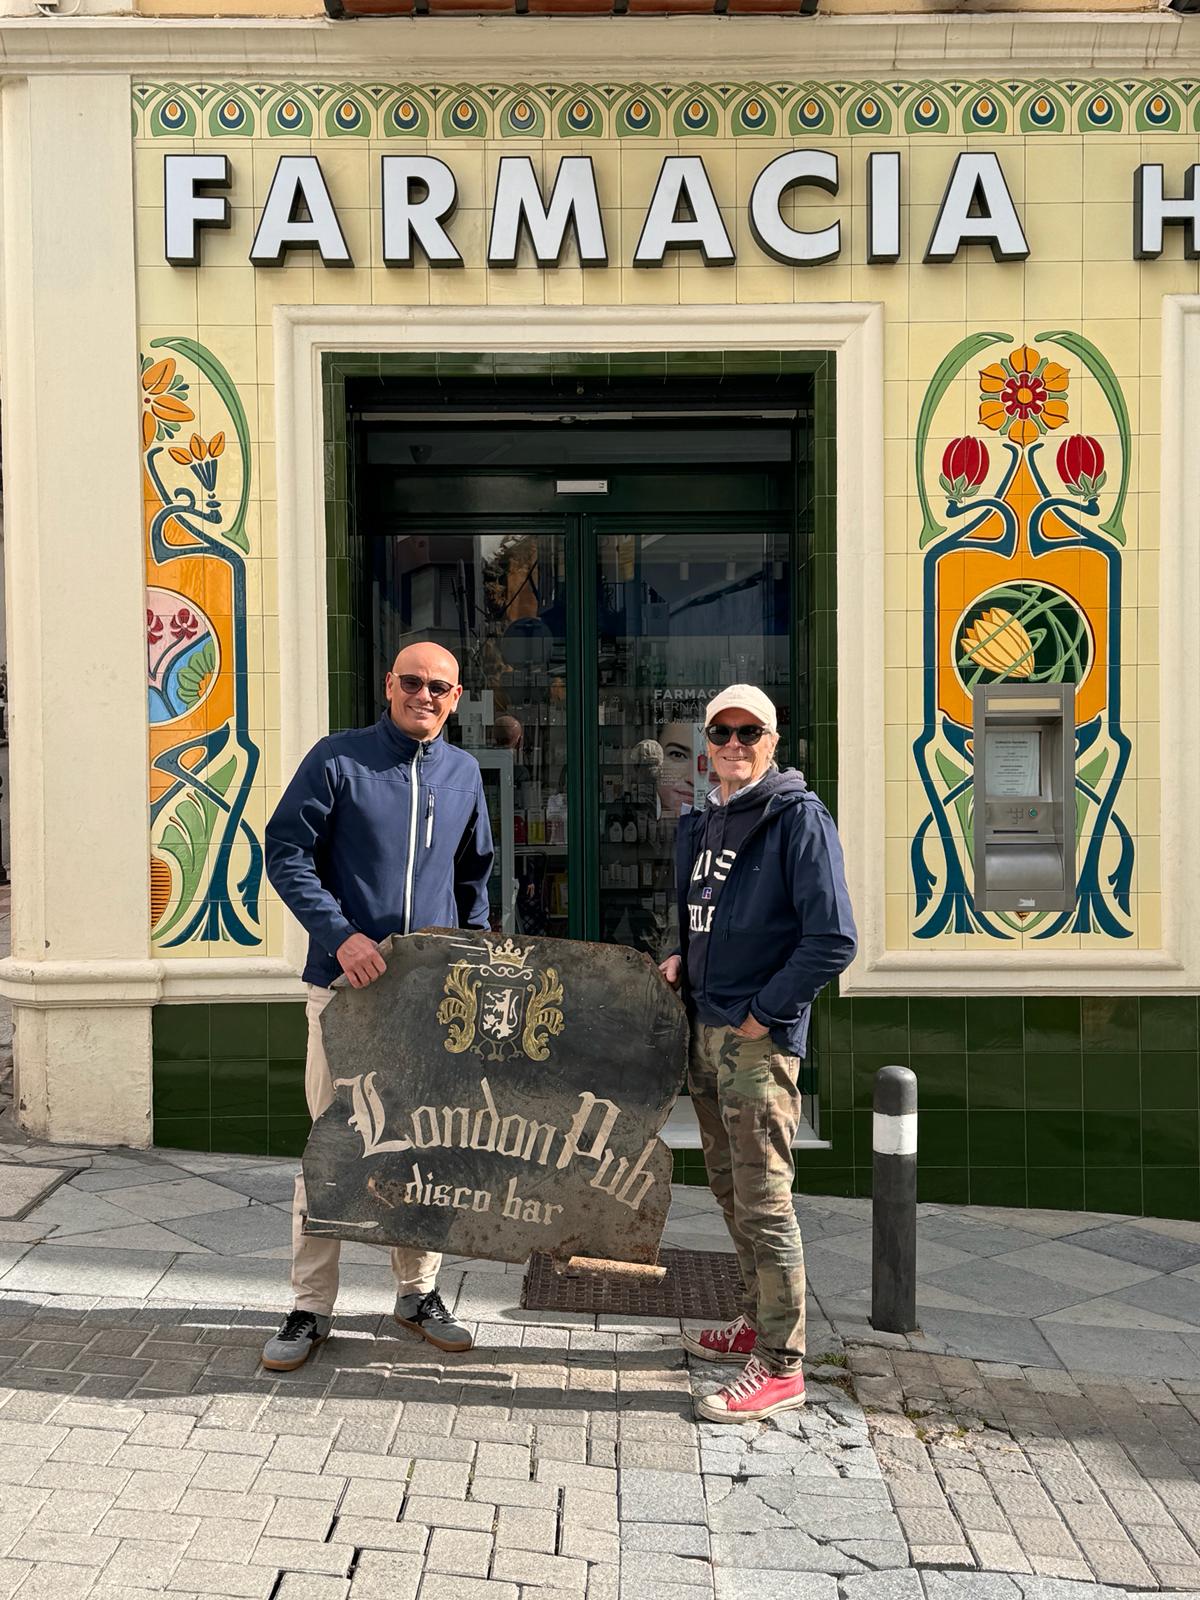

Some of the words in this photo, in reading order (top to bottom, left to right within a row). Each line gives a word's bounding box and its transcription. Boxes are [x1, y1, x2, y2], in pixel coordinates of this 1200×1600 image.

[164, 150, 1030, 269] FARMACIA
[1133, 163, 1200, 260] H
[333, 1071, 557, 1165] London
[555, 1091, 658, 1210] Pub
[403, 1162, 492, 1213] disco
[502, 1176, 564, 1225] bar
